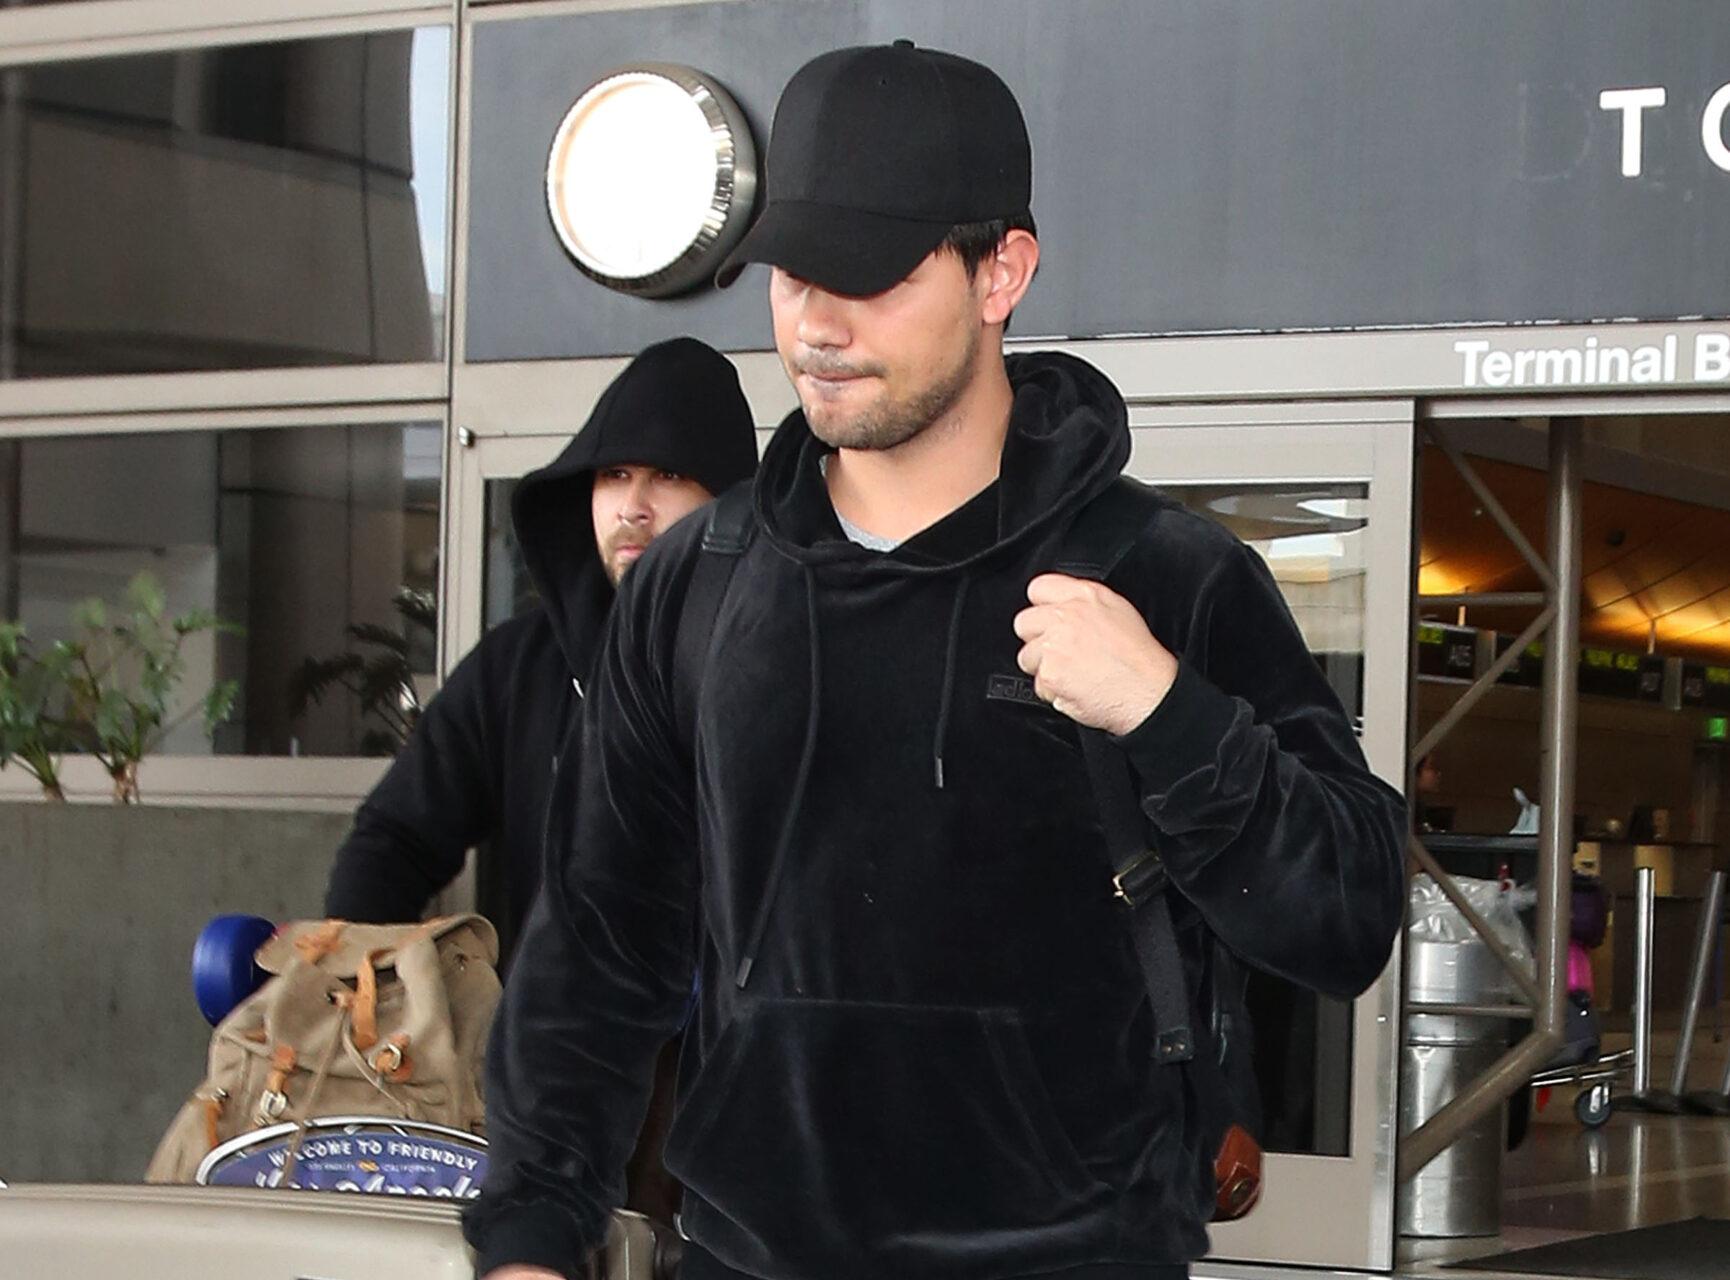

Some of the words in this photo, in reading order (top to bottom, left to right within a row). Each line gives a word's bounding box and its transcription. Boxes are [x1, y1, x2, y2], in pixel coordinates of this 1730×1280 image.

[1454, 335, 1678, 386] Terminal
[1694, 334, 1730, 381] B
[356, 1139, 382, 1155] TO
[387, 1141, 478, 1170] FRIENDLY
